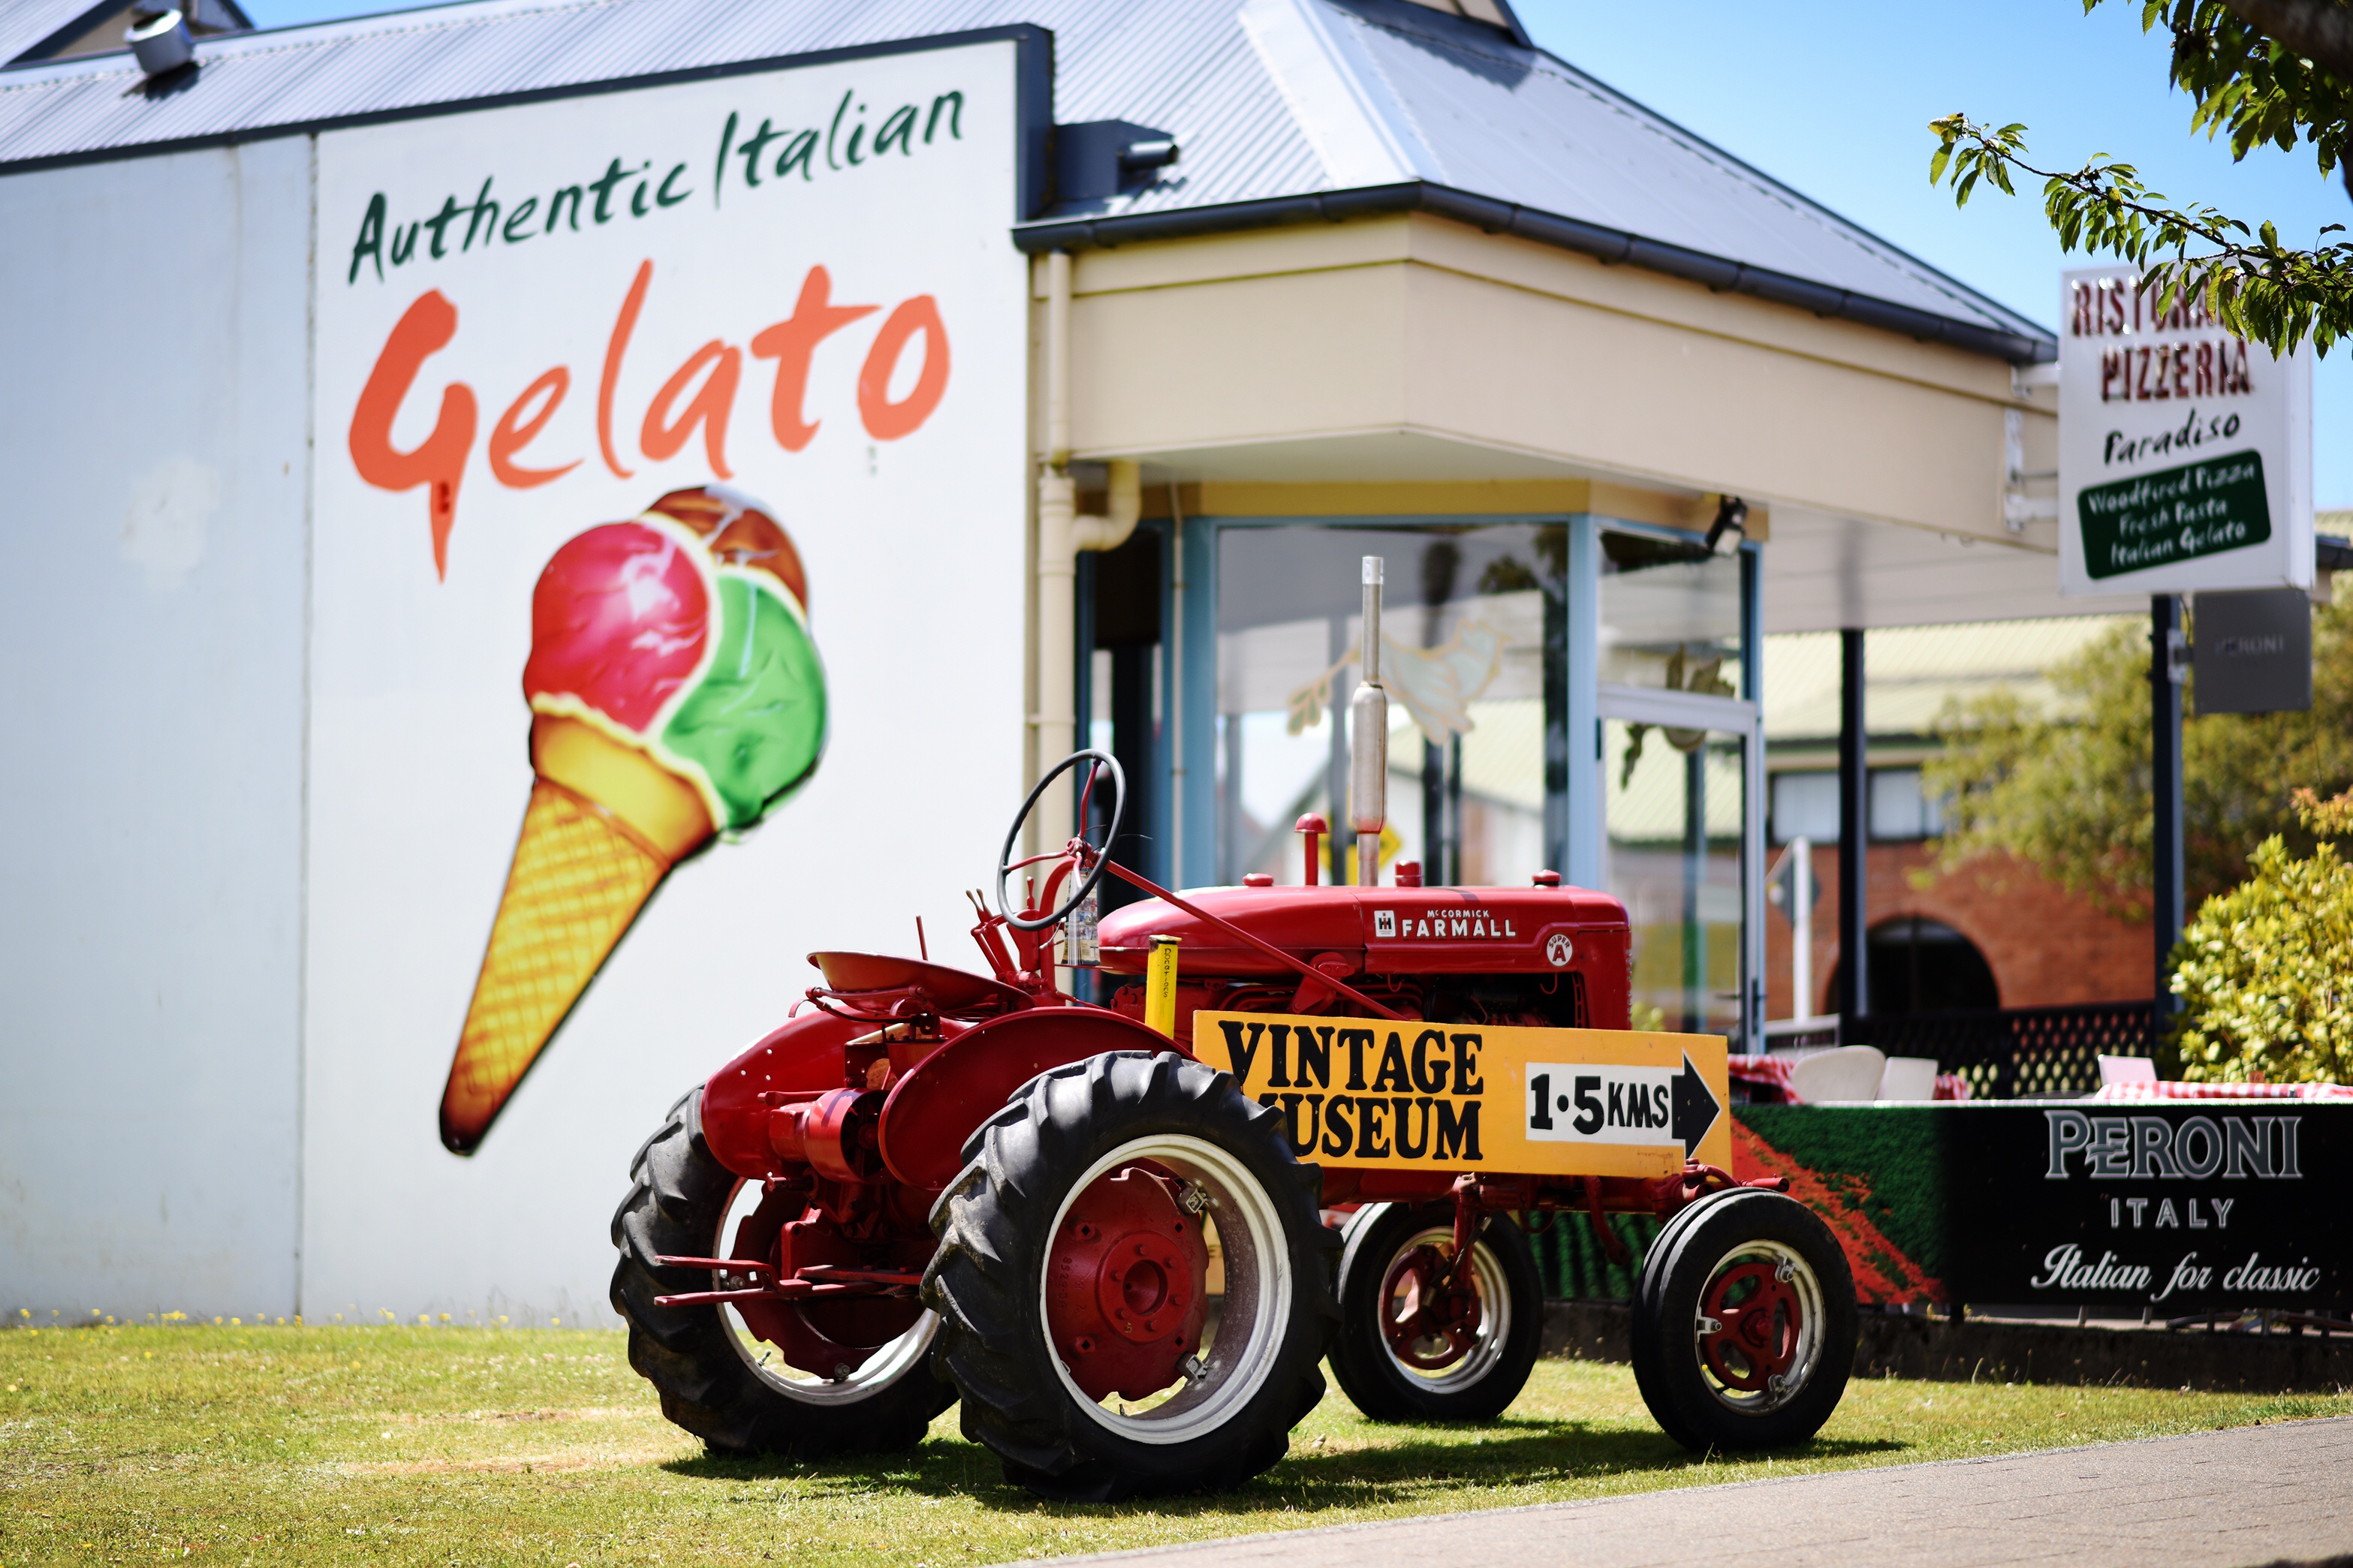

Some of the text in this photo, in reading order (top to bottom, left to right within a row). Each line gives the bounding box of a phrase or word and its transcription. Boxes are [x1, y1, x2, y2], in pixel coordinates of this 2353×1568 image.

[348, 89, 964, 285] Authentic Italian
[2101, 339, 2251, 402] PIZZERIA
[348, 259, 951, 584] Gelato
[2104, 407, 2240, 465] Paradiso
[2195, 462, 2255, 491] Pizza
[2111, 520, 2246, 568] Italian Gelato
[2120, 496, 2228, 540] Fresh Pasta
[1402, 919, 1517, 937] FARMALL
[1548, 935, 1571, 949] SUPER
[1552, 944, 1567, 962] A
[1219, 1019, 1484, 1095] VINTAGE
[1258, 1092, 1484, 1161] USEUM
[1607, 1082, 1670, 1129] KMS
[2044, 1109, 2303, 1179] PERONI
[2110, 1198, 2235, 1228] ITALY
[2030, 1243, 2321, 1303] Italian for classic
